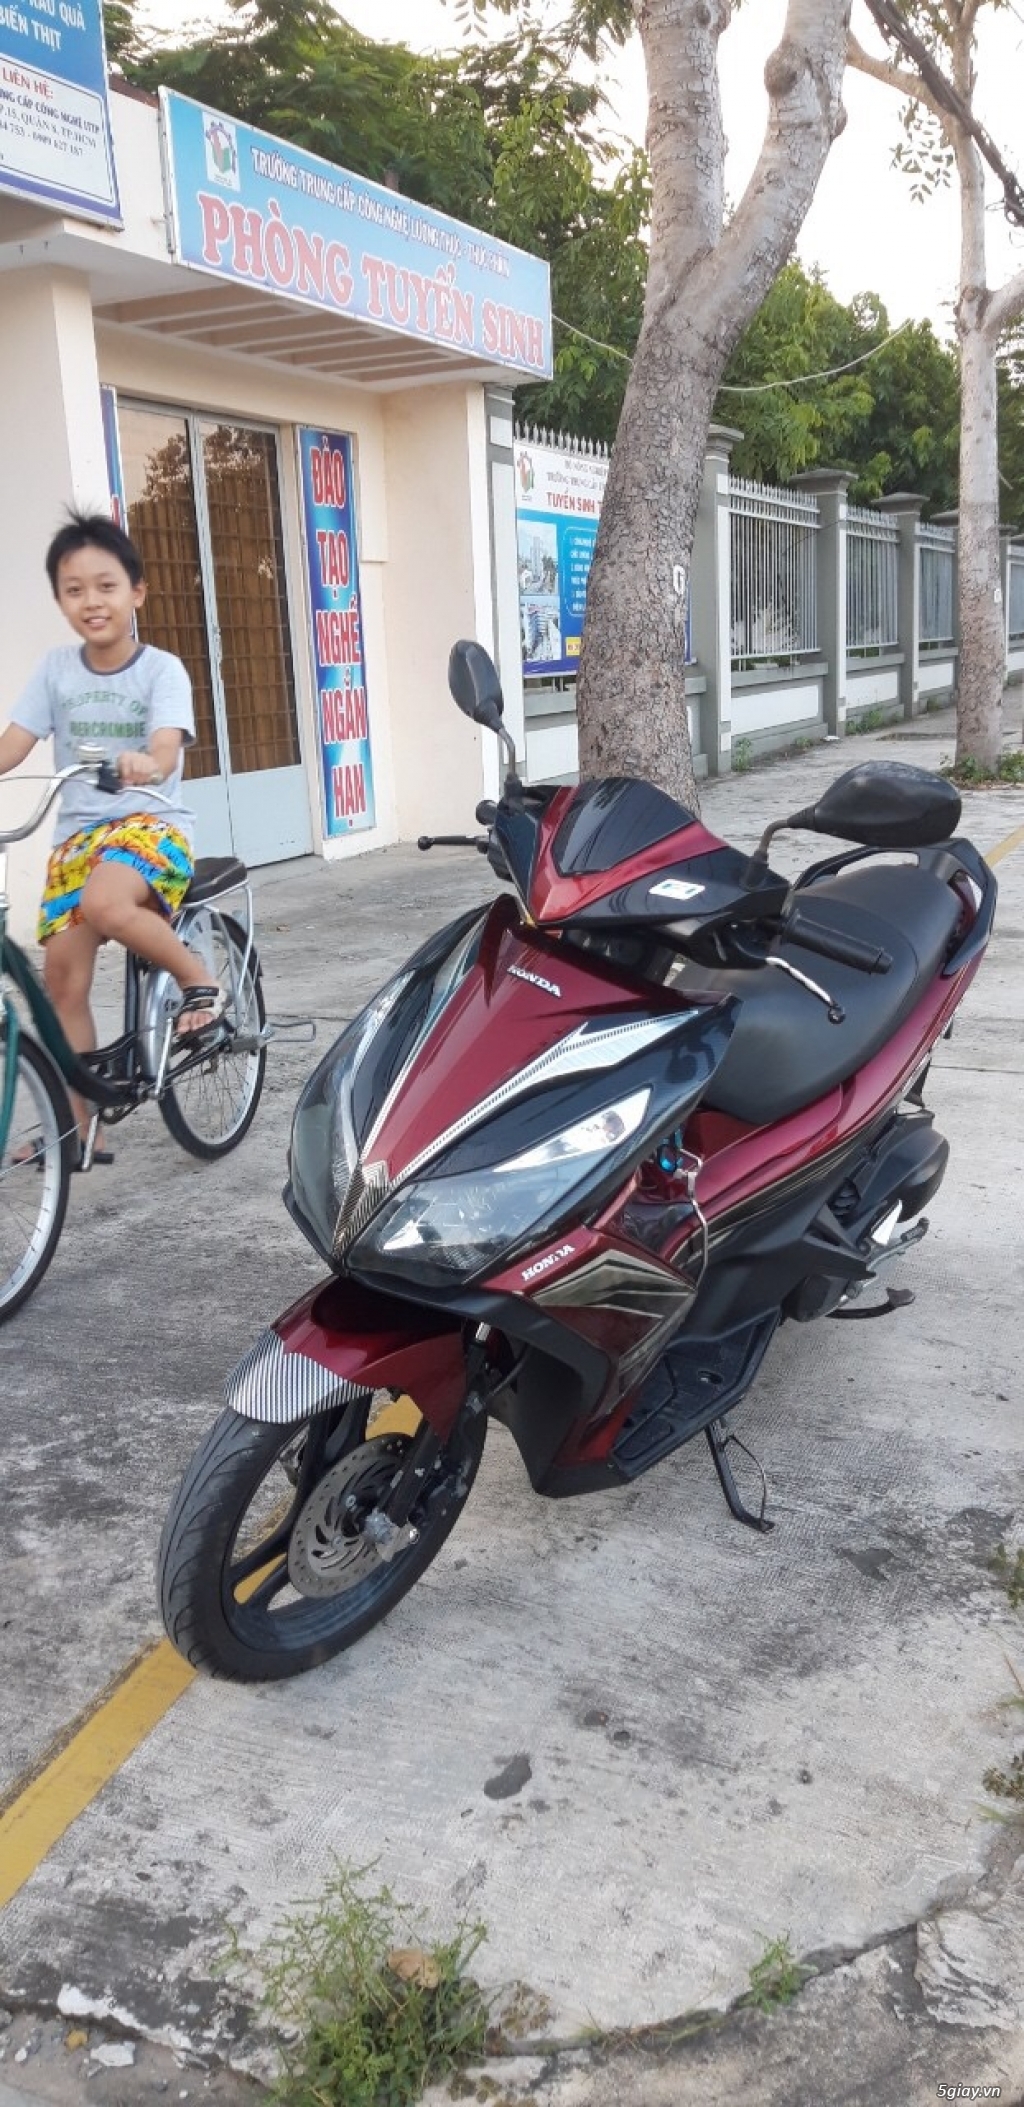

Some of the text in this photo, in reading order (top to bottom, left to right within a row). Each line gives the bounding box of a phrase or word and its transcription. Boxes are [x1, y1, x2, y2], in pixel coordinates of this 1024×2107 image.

[30, 19, 62, 52] THỊT
[2, 66, 31, 90] LIÊN
[250, 145, 299, 191] TRƯỜNG
[299, 166, 336, 207] TRUNG
[197, 193, 546, 369] PHÒNG TUYỂN SINH
[309, 435, 347, 509] ĐÀO
[546, 486, 576, 511] TUYỂN
[577, 496, 596, 513] SINH
[315, 529, 350, 600] TẠO
[332, 763, 367, 827] HẠN
[506, 964, 562, 998] HONDA
